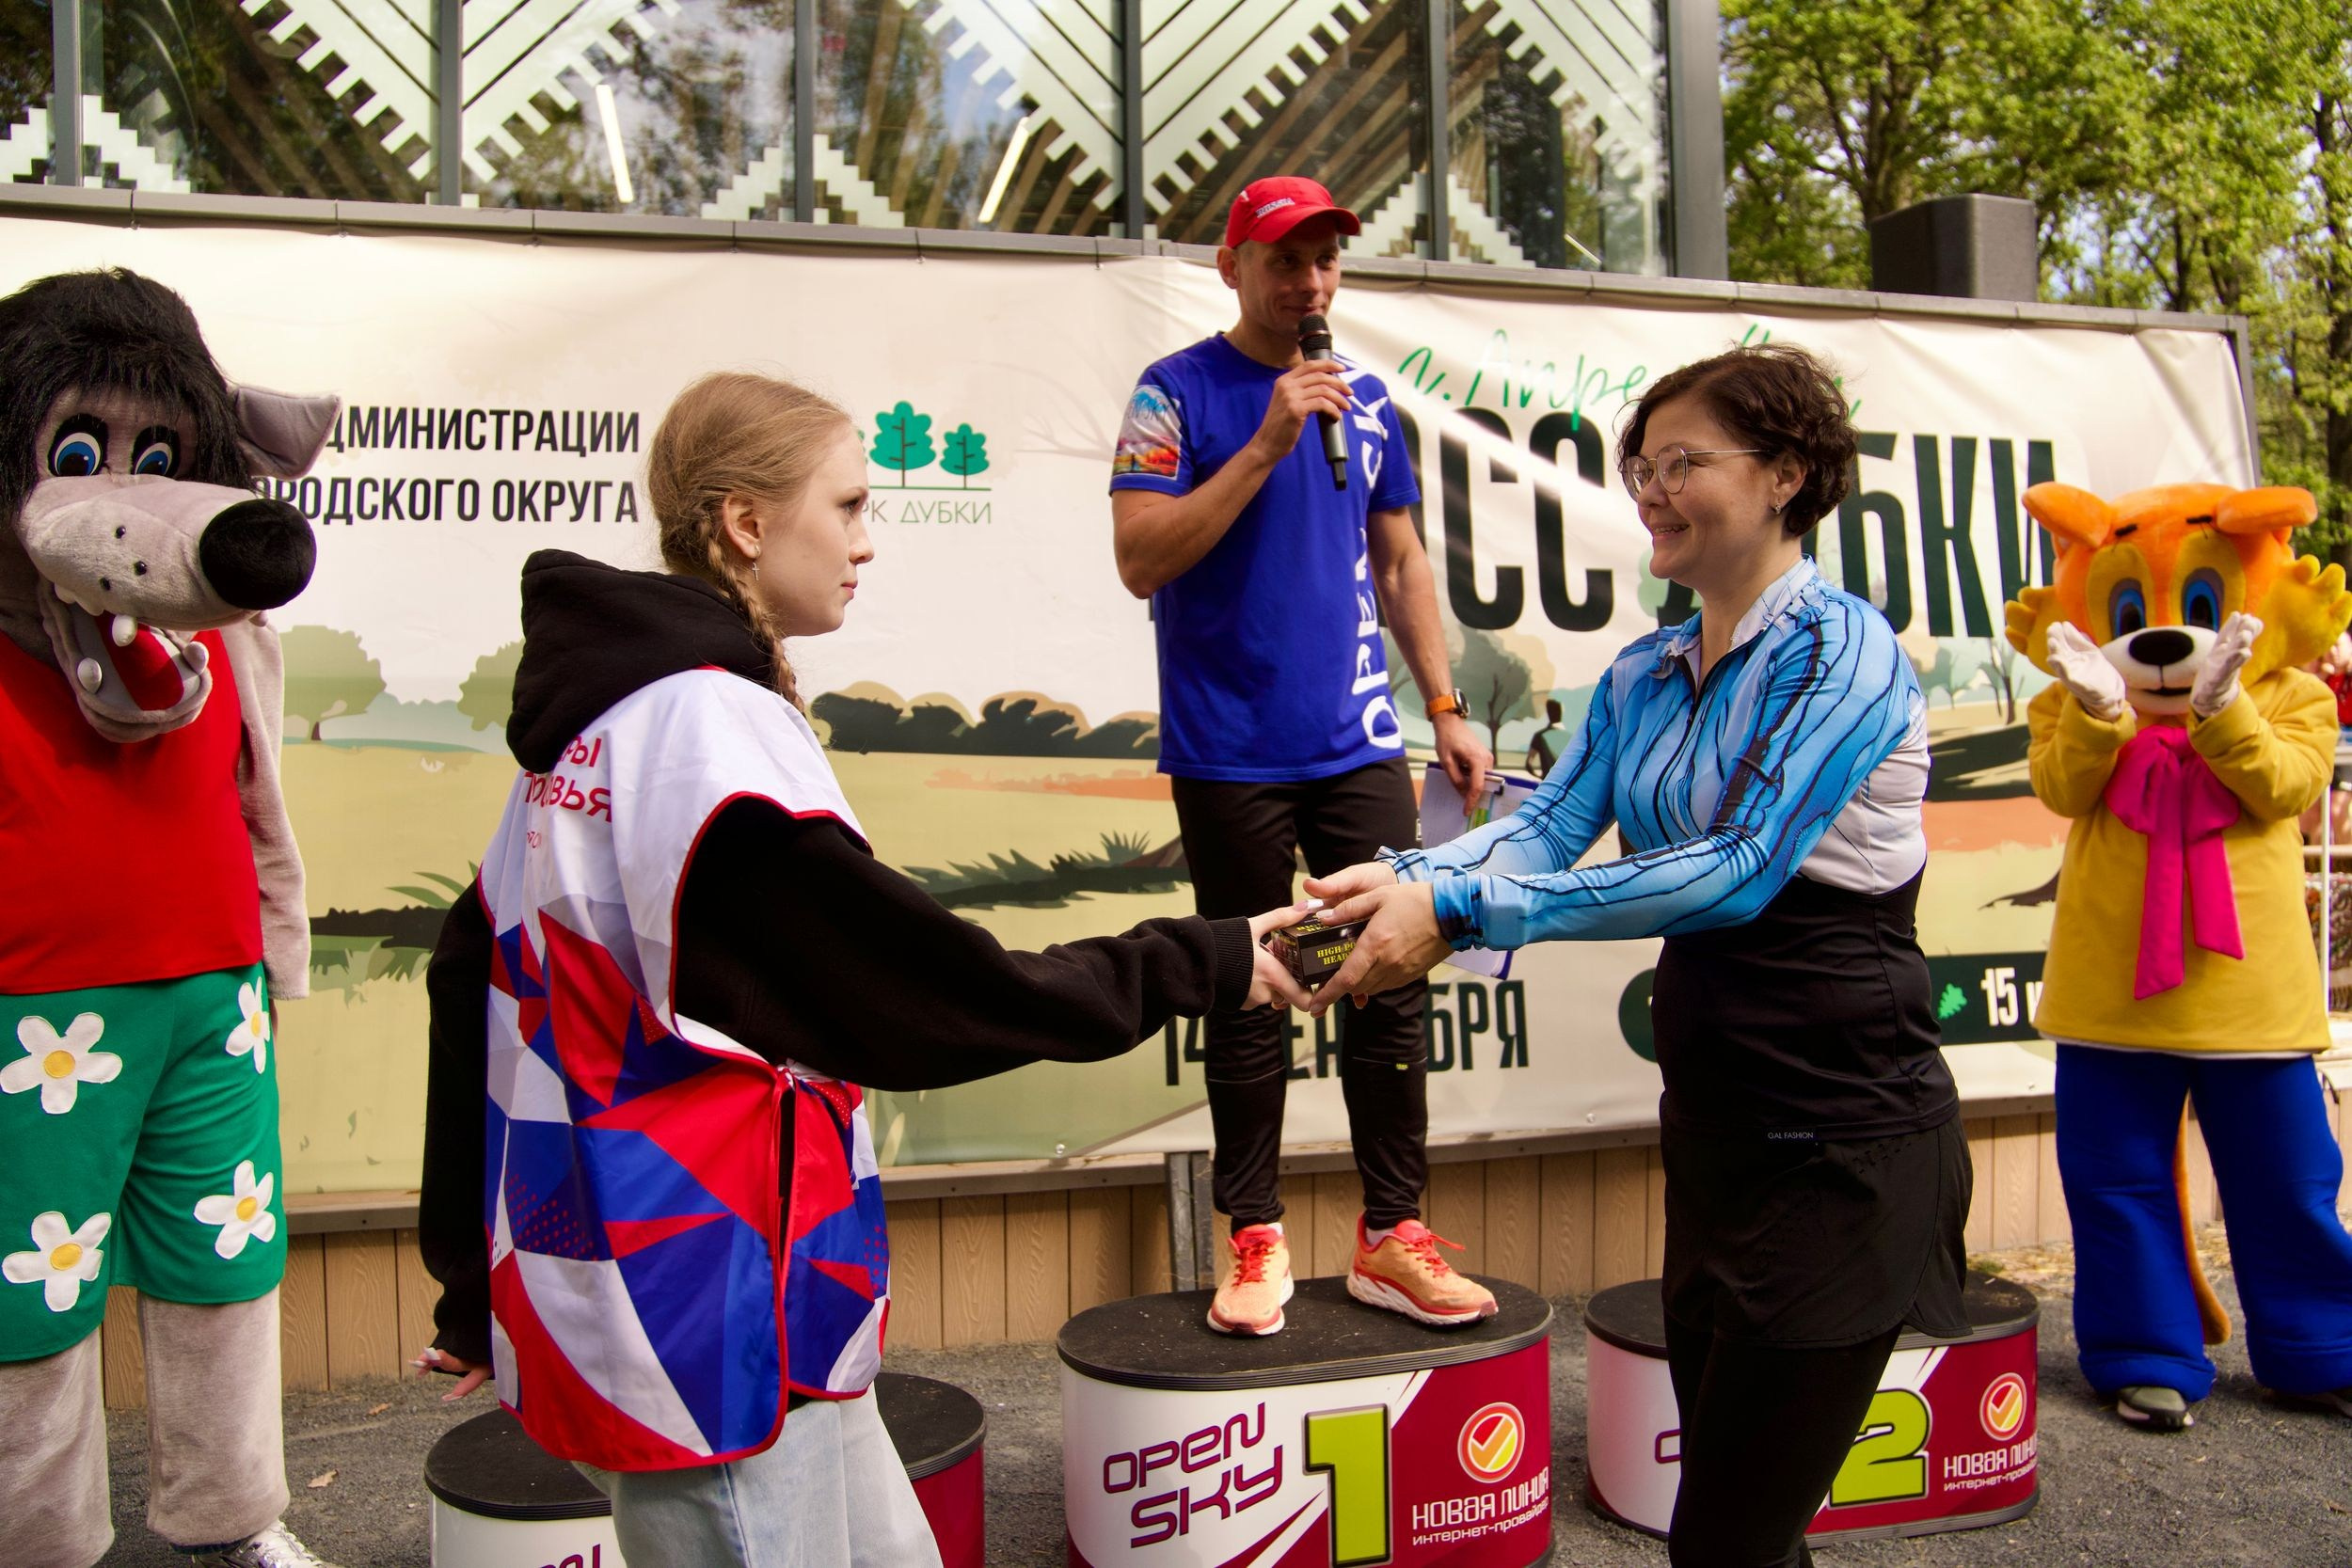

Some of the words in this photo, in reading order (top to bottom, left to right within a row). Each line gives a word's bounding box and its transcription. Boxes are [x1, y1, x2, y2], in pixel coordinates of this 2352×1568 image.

[326, 405, 640, 458] ДМИНИСТРАЦИИ
[492, 479, 640, 523] ОКРУГА
[899, 499, 993, 525] ДУБКИ
[1799, 429, 2062, 640] БКИ
[1316, 946, 1341, 958] HIGH
[1979, 966, 2020, 1027] 15
[1282, 980, 1529, 1081] ЕНБРЯ
[1767, 1132, 1783, 1140] GAL
[1784, 1132, 1814, 1140] FASHION
[1828, 1386, 1932, 1511] 2
[1943, 1448, 2008, 1479] НОВАЯ
[1302, 1402, 1393, 1568] 1
[1412, 1493, 1496, 1530] НОВАЯ
[1501, 1465, 1549, 1515] ЛИНИЯ
[1412, 1496, 1549, 1546] интернет-провайдер
